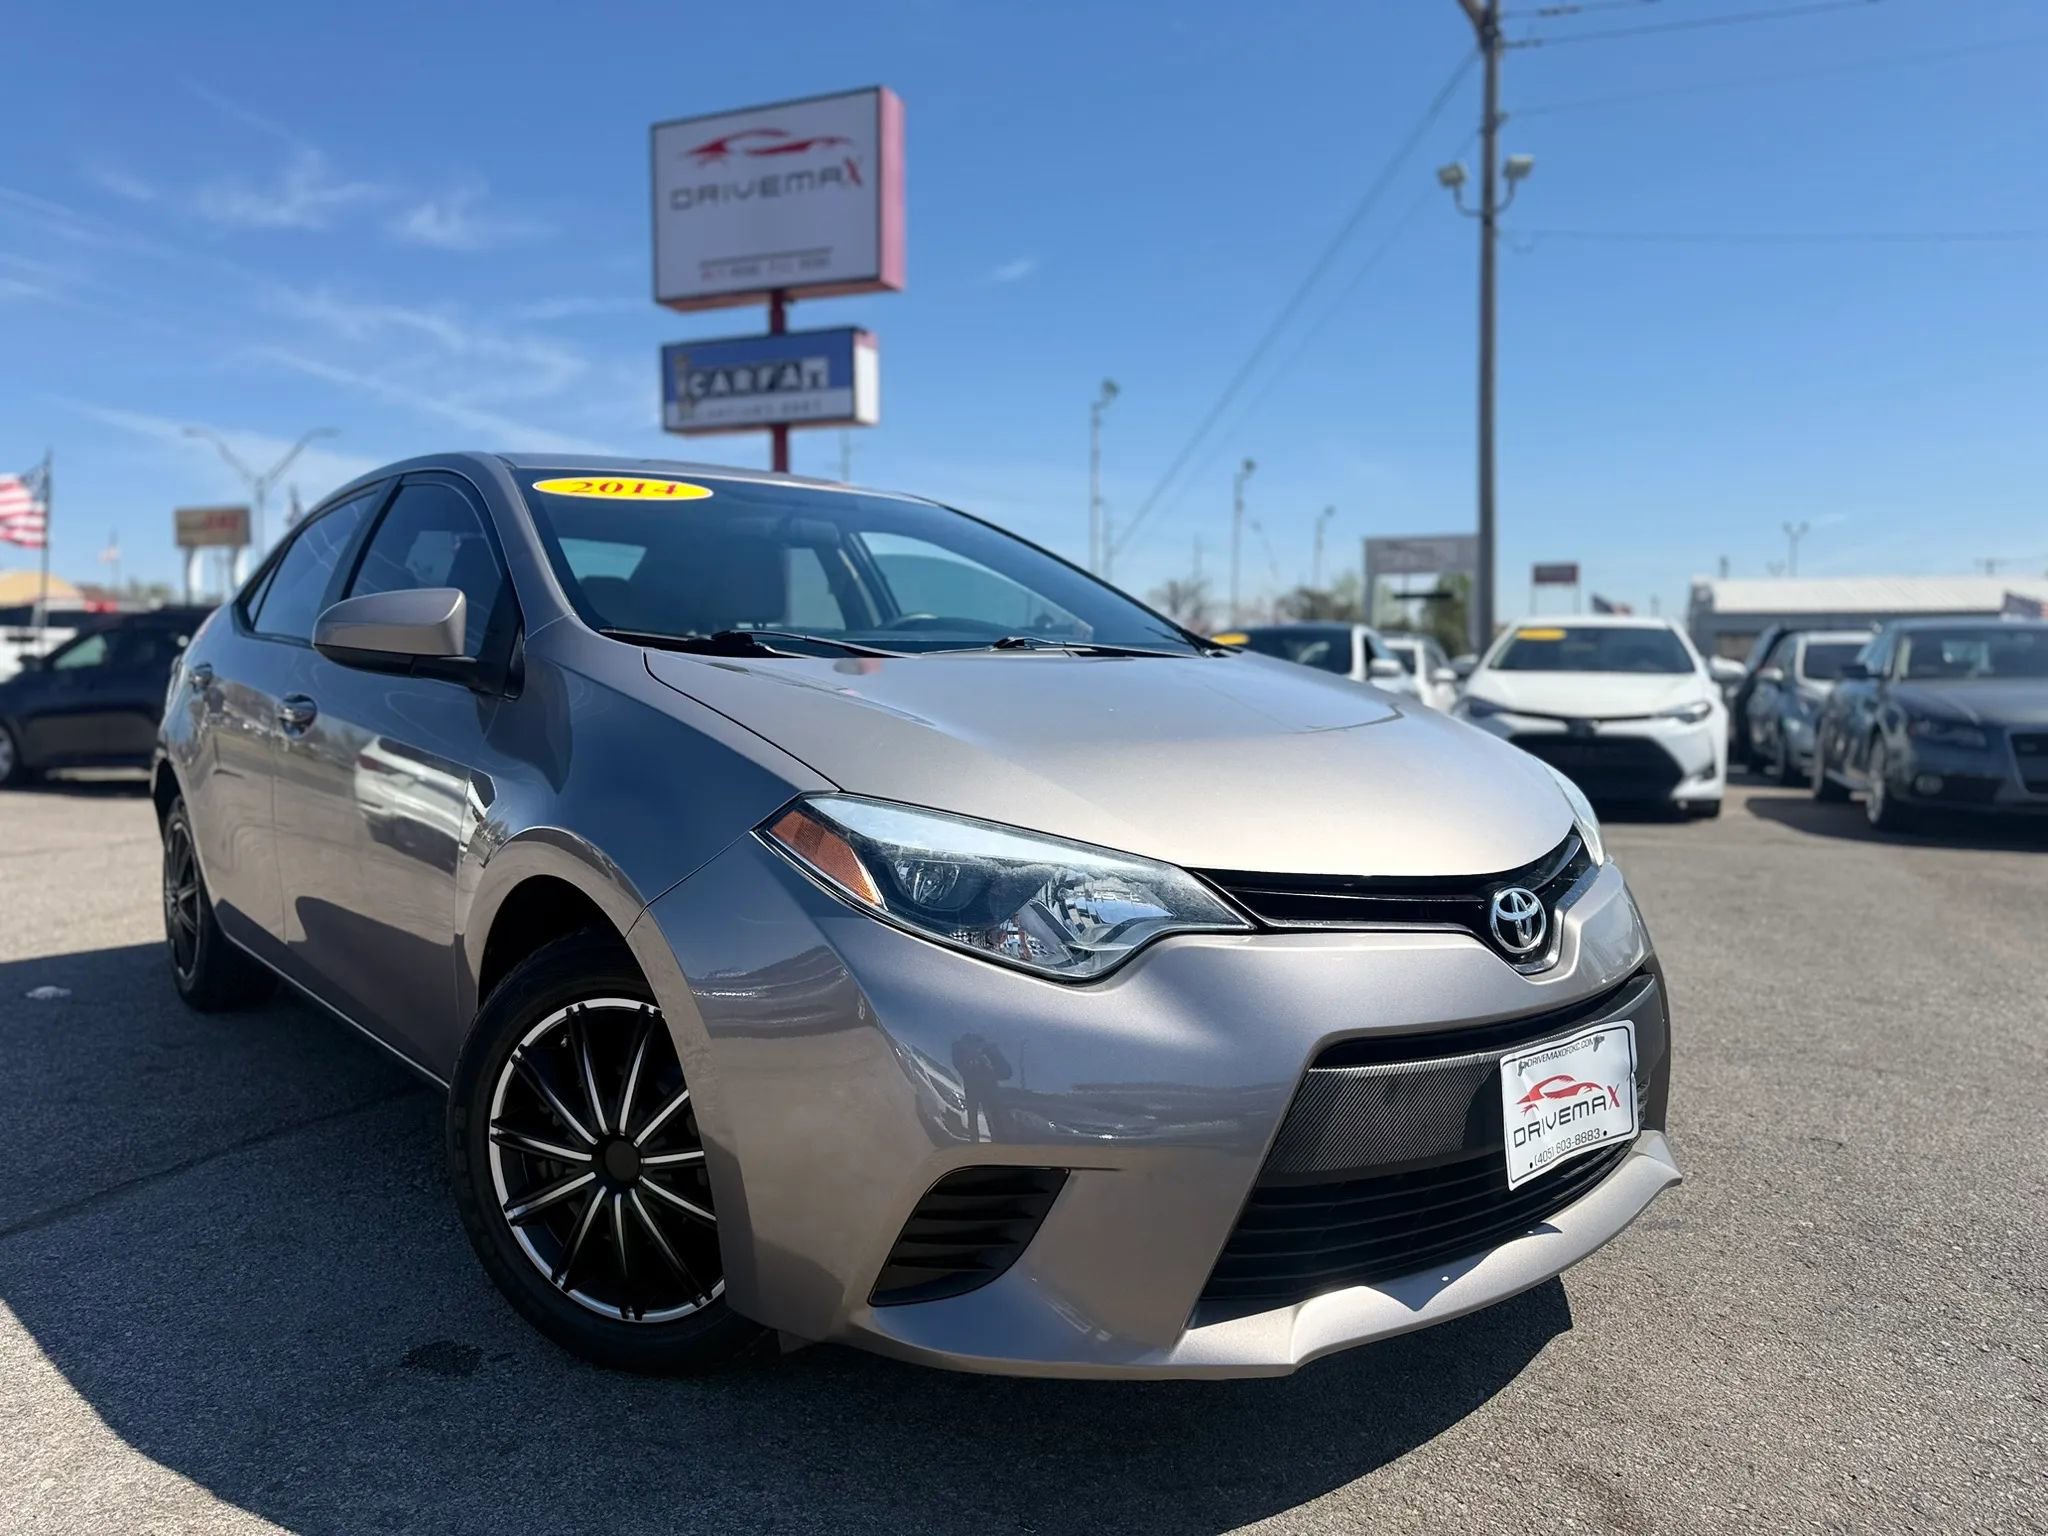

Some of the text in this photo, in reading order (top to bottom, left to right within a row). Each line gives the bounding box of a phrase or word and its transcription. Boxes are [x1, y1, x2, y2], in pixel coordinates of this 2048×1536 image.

[669, 157, 863, 210] DRIVEMAX
[569, 480, 678, 495] 2014
[1514, 1085, 1620, 1148] DRIVEMAX
[1534, 1128, 1601, 1166] (405) 603-8883
